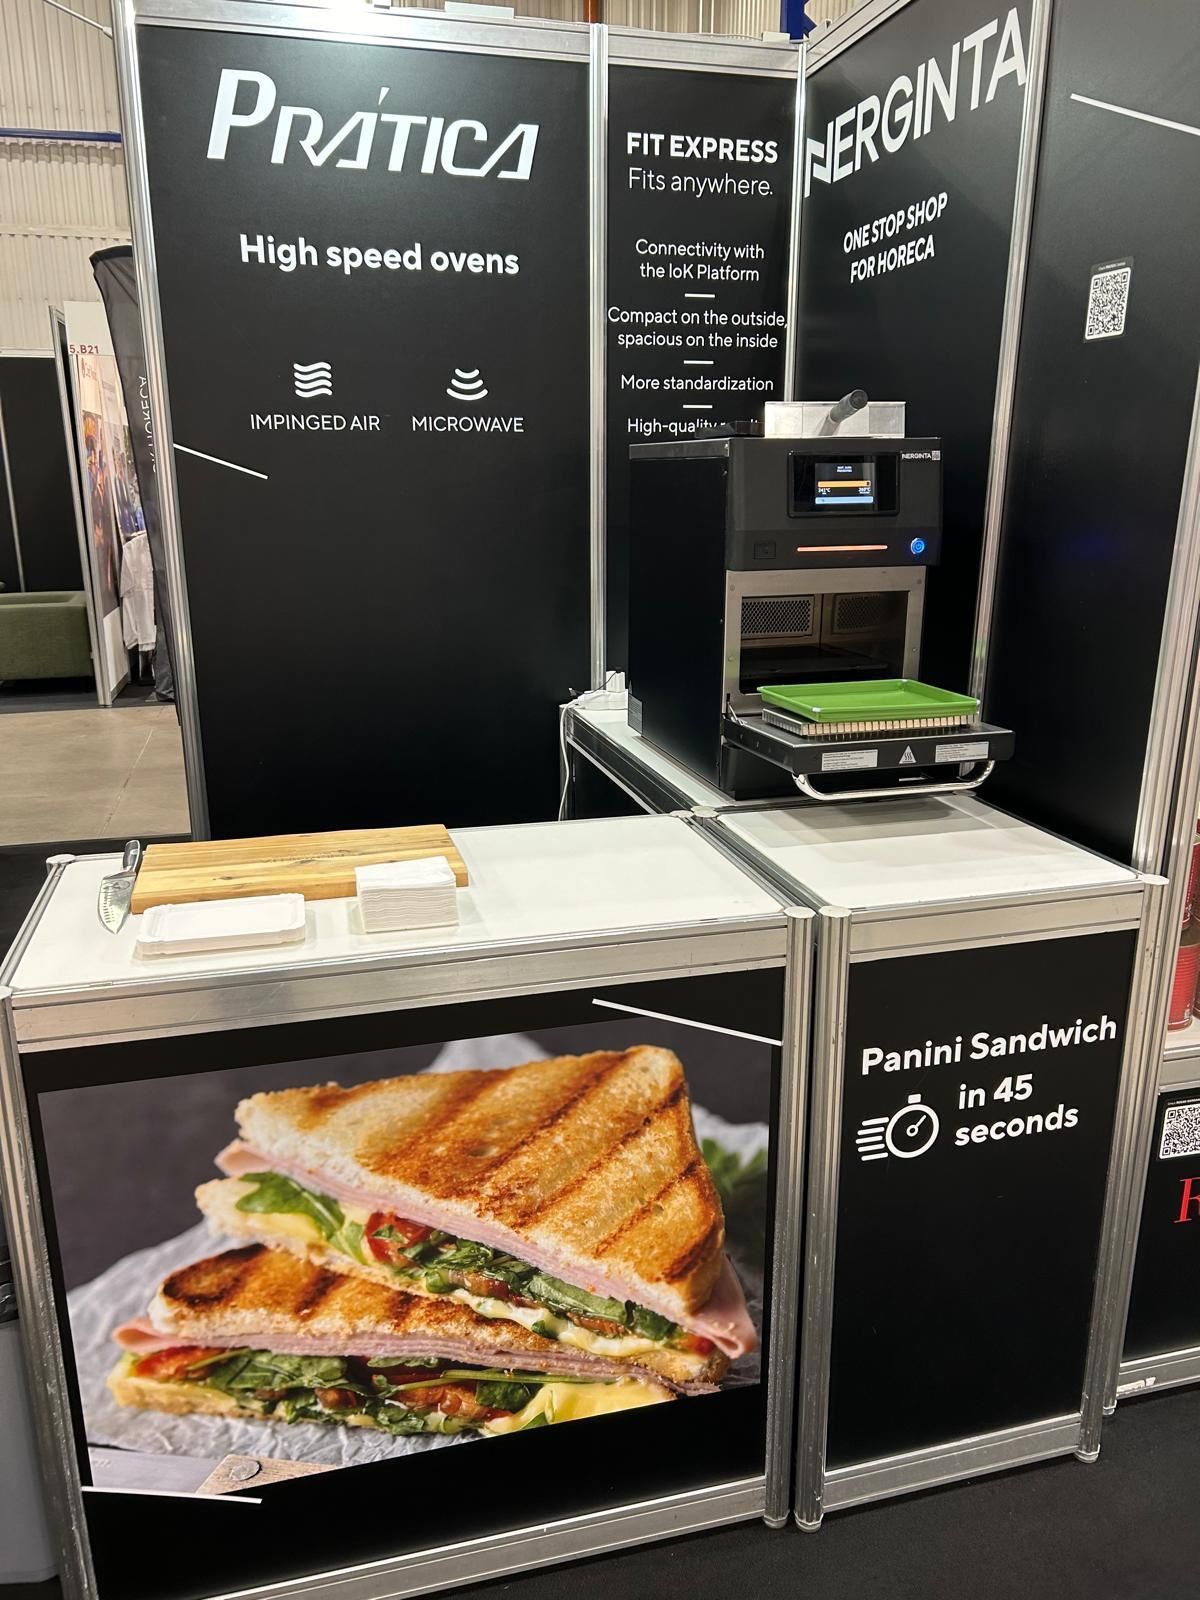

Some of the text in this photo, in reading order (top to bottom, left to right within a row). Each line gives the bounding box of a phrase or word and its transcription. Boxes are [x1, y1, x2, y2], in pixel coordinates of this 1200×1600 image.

[626, 131, 779, 164] FIT EXPRESS
[628, 166, 774, 198] Fits anywhere.
[844, 192, 948, 253] ONE STOP SHOP
[239, 233, 520, 276] High speed ovens
[635, 238, 765, 262] Connectivity with
[850, 234, 935, 284] FOR HORECA
[639, 261, 760, 283] the IoK Platform
[607, 306, 787, 329] Compact on the outside,
[69, 344, 99, 354] 5.B21
[617, 331, 778, 349] spacious on the inside
[621, 374, 774, 392] More standardization
[250, 413, 381, 432] IMPINGED AIR
[412, 415, 525, 433] MICROWAVE
[861, 1015, 1117, 1076] Panini Sandwich
[958, 1073, 1034, 1110] in 45
[954, 1103, 1079, 1147] seconds
